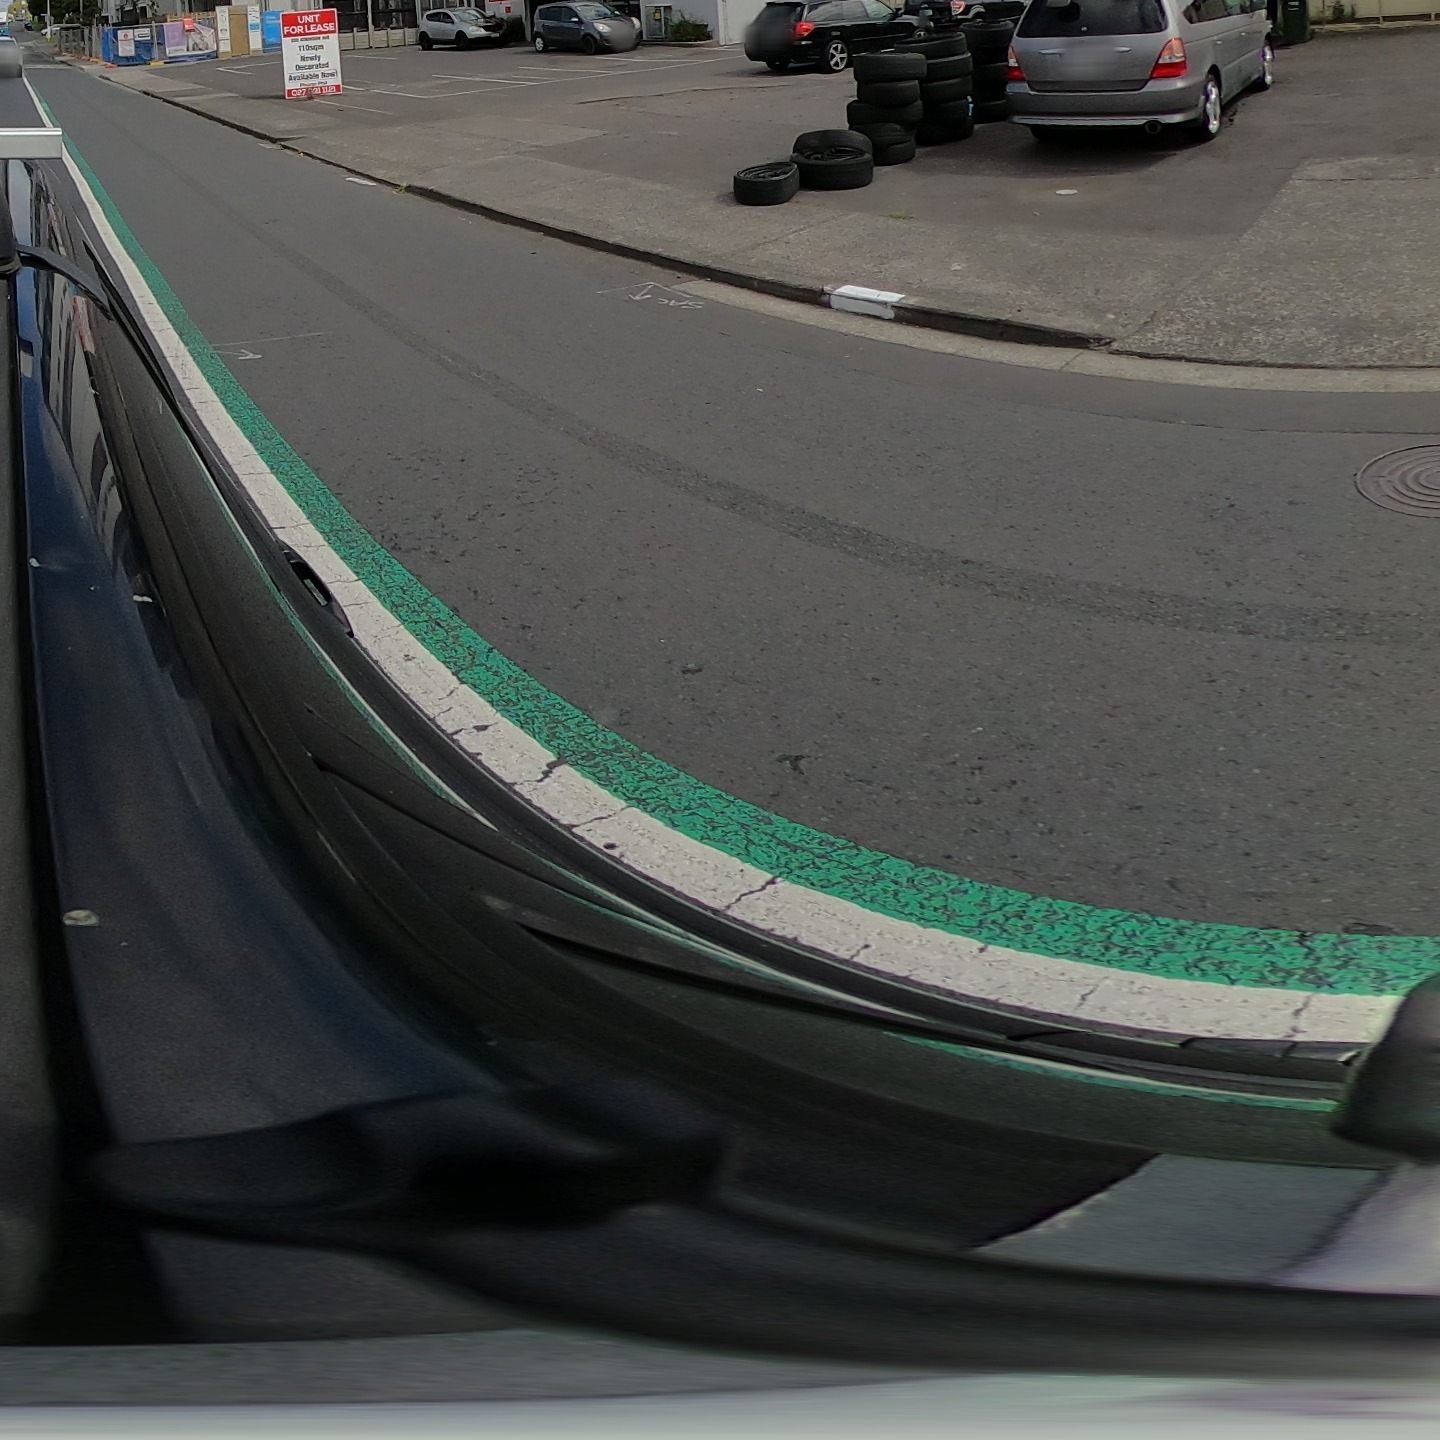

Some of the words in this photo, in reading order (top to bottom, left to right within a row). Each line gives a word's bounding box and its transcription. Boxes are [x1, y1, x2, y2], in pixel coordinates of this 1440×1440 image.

[297, 14, 320, 24] UNIT
[284, 26, 304, 35] FOR
[305, 22, 335, 33] LEASE
